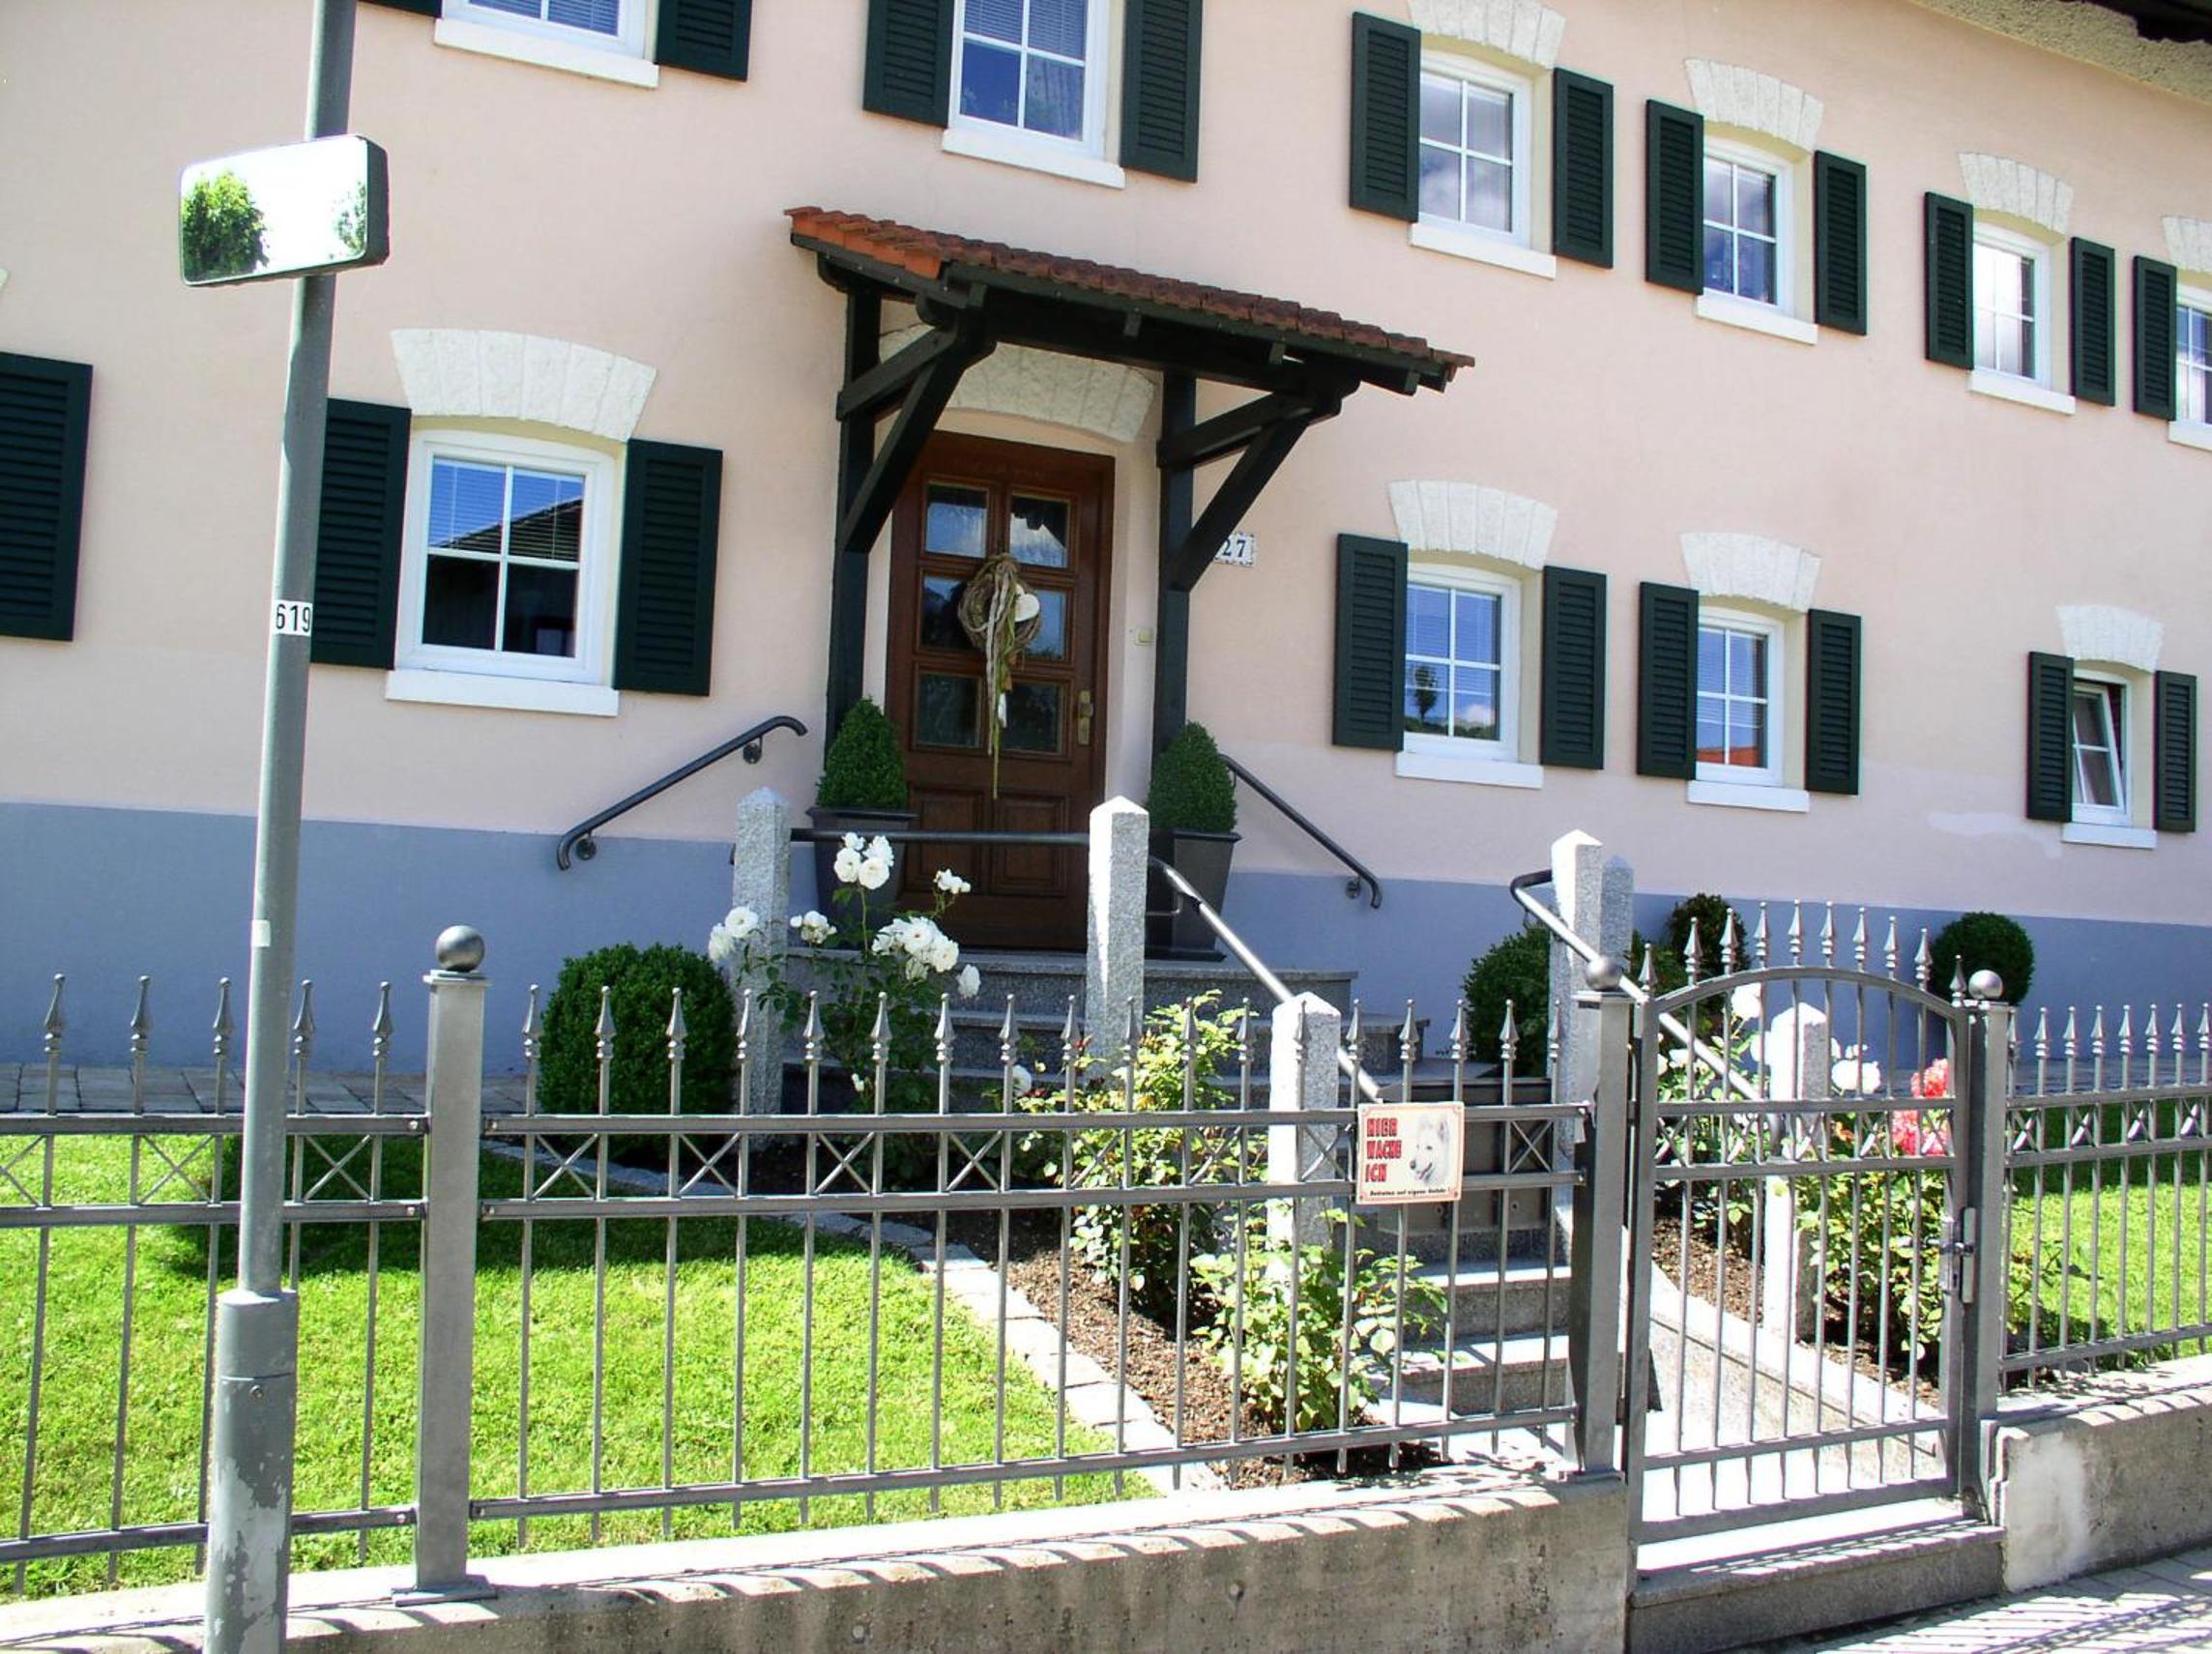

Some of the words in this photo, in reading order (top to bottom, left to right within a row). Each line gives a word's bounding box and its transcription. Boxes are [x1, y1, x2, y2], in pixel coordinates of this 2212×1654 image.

[1222, 538, 1246, 558] 27
[276, 603, 310, 632] 619
[1366, 1117, 1398, 1137] HIER
[1366, 1140, 1402, 1159] WACHE
[1365, 1164, 1387, 1182] ICH
